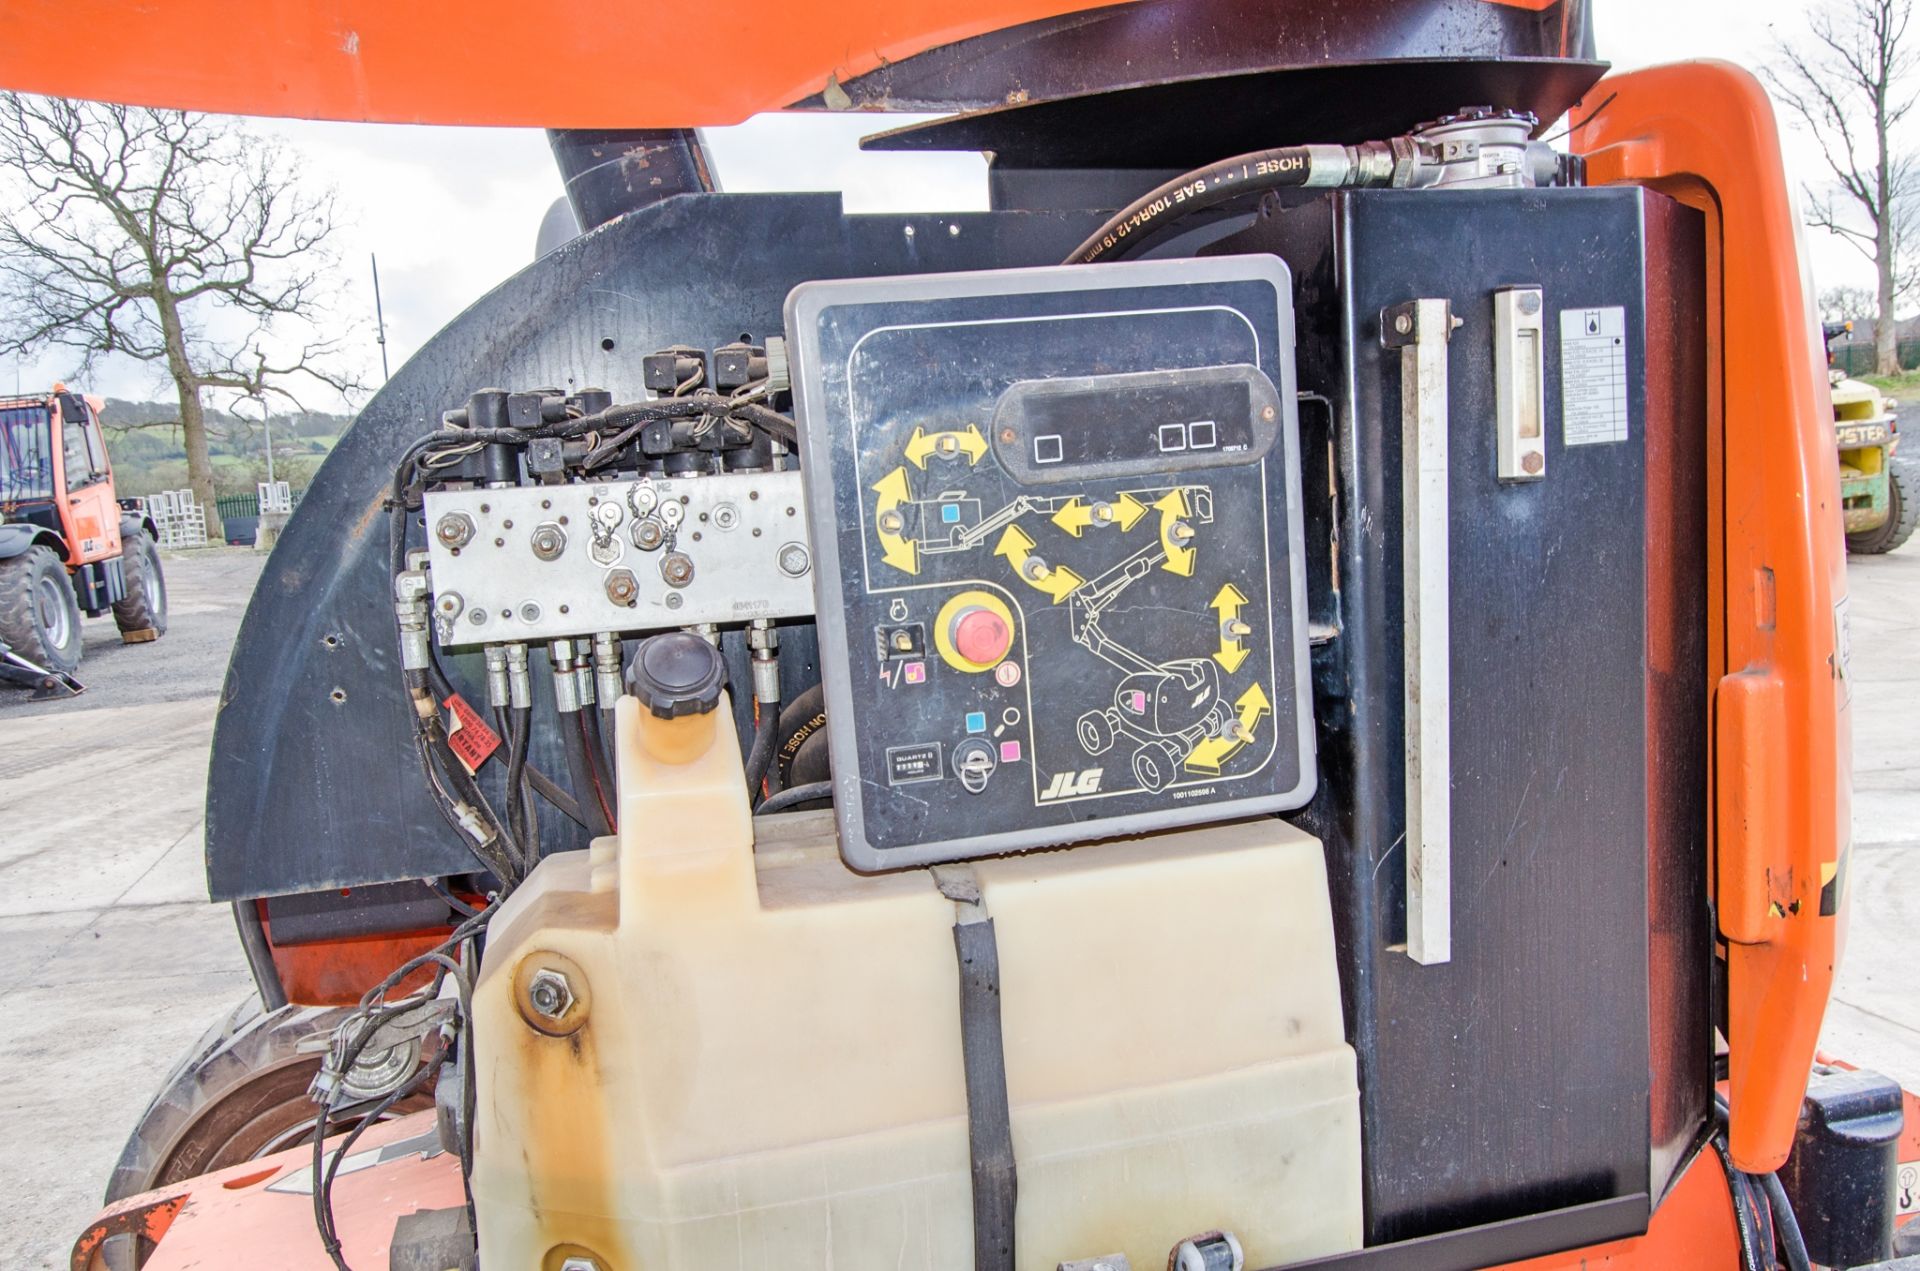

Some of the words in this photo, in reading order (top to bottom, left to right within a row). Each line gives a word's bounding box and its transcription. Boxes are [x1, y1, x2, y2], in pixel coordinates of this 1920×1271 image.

[1256, 157, 1303, 175] HOSE
[1173, 180, 1207, 203] SAE
[1116, 196, 1172, 238] 100R4-12
[1103, 233, 1118, 249] 19
[784, 725, 812, 753] HOSE
[1039, 767, 1104, 801] JLG
[1210, 787, 1216, 795] A
